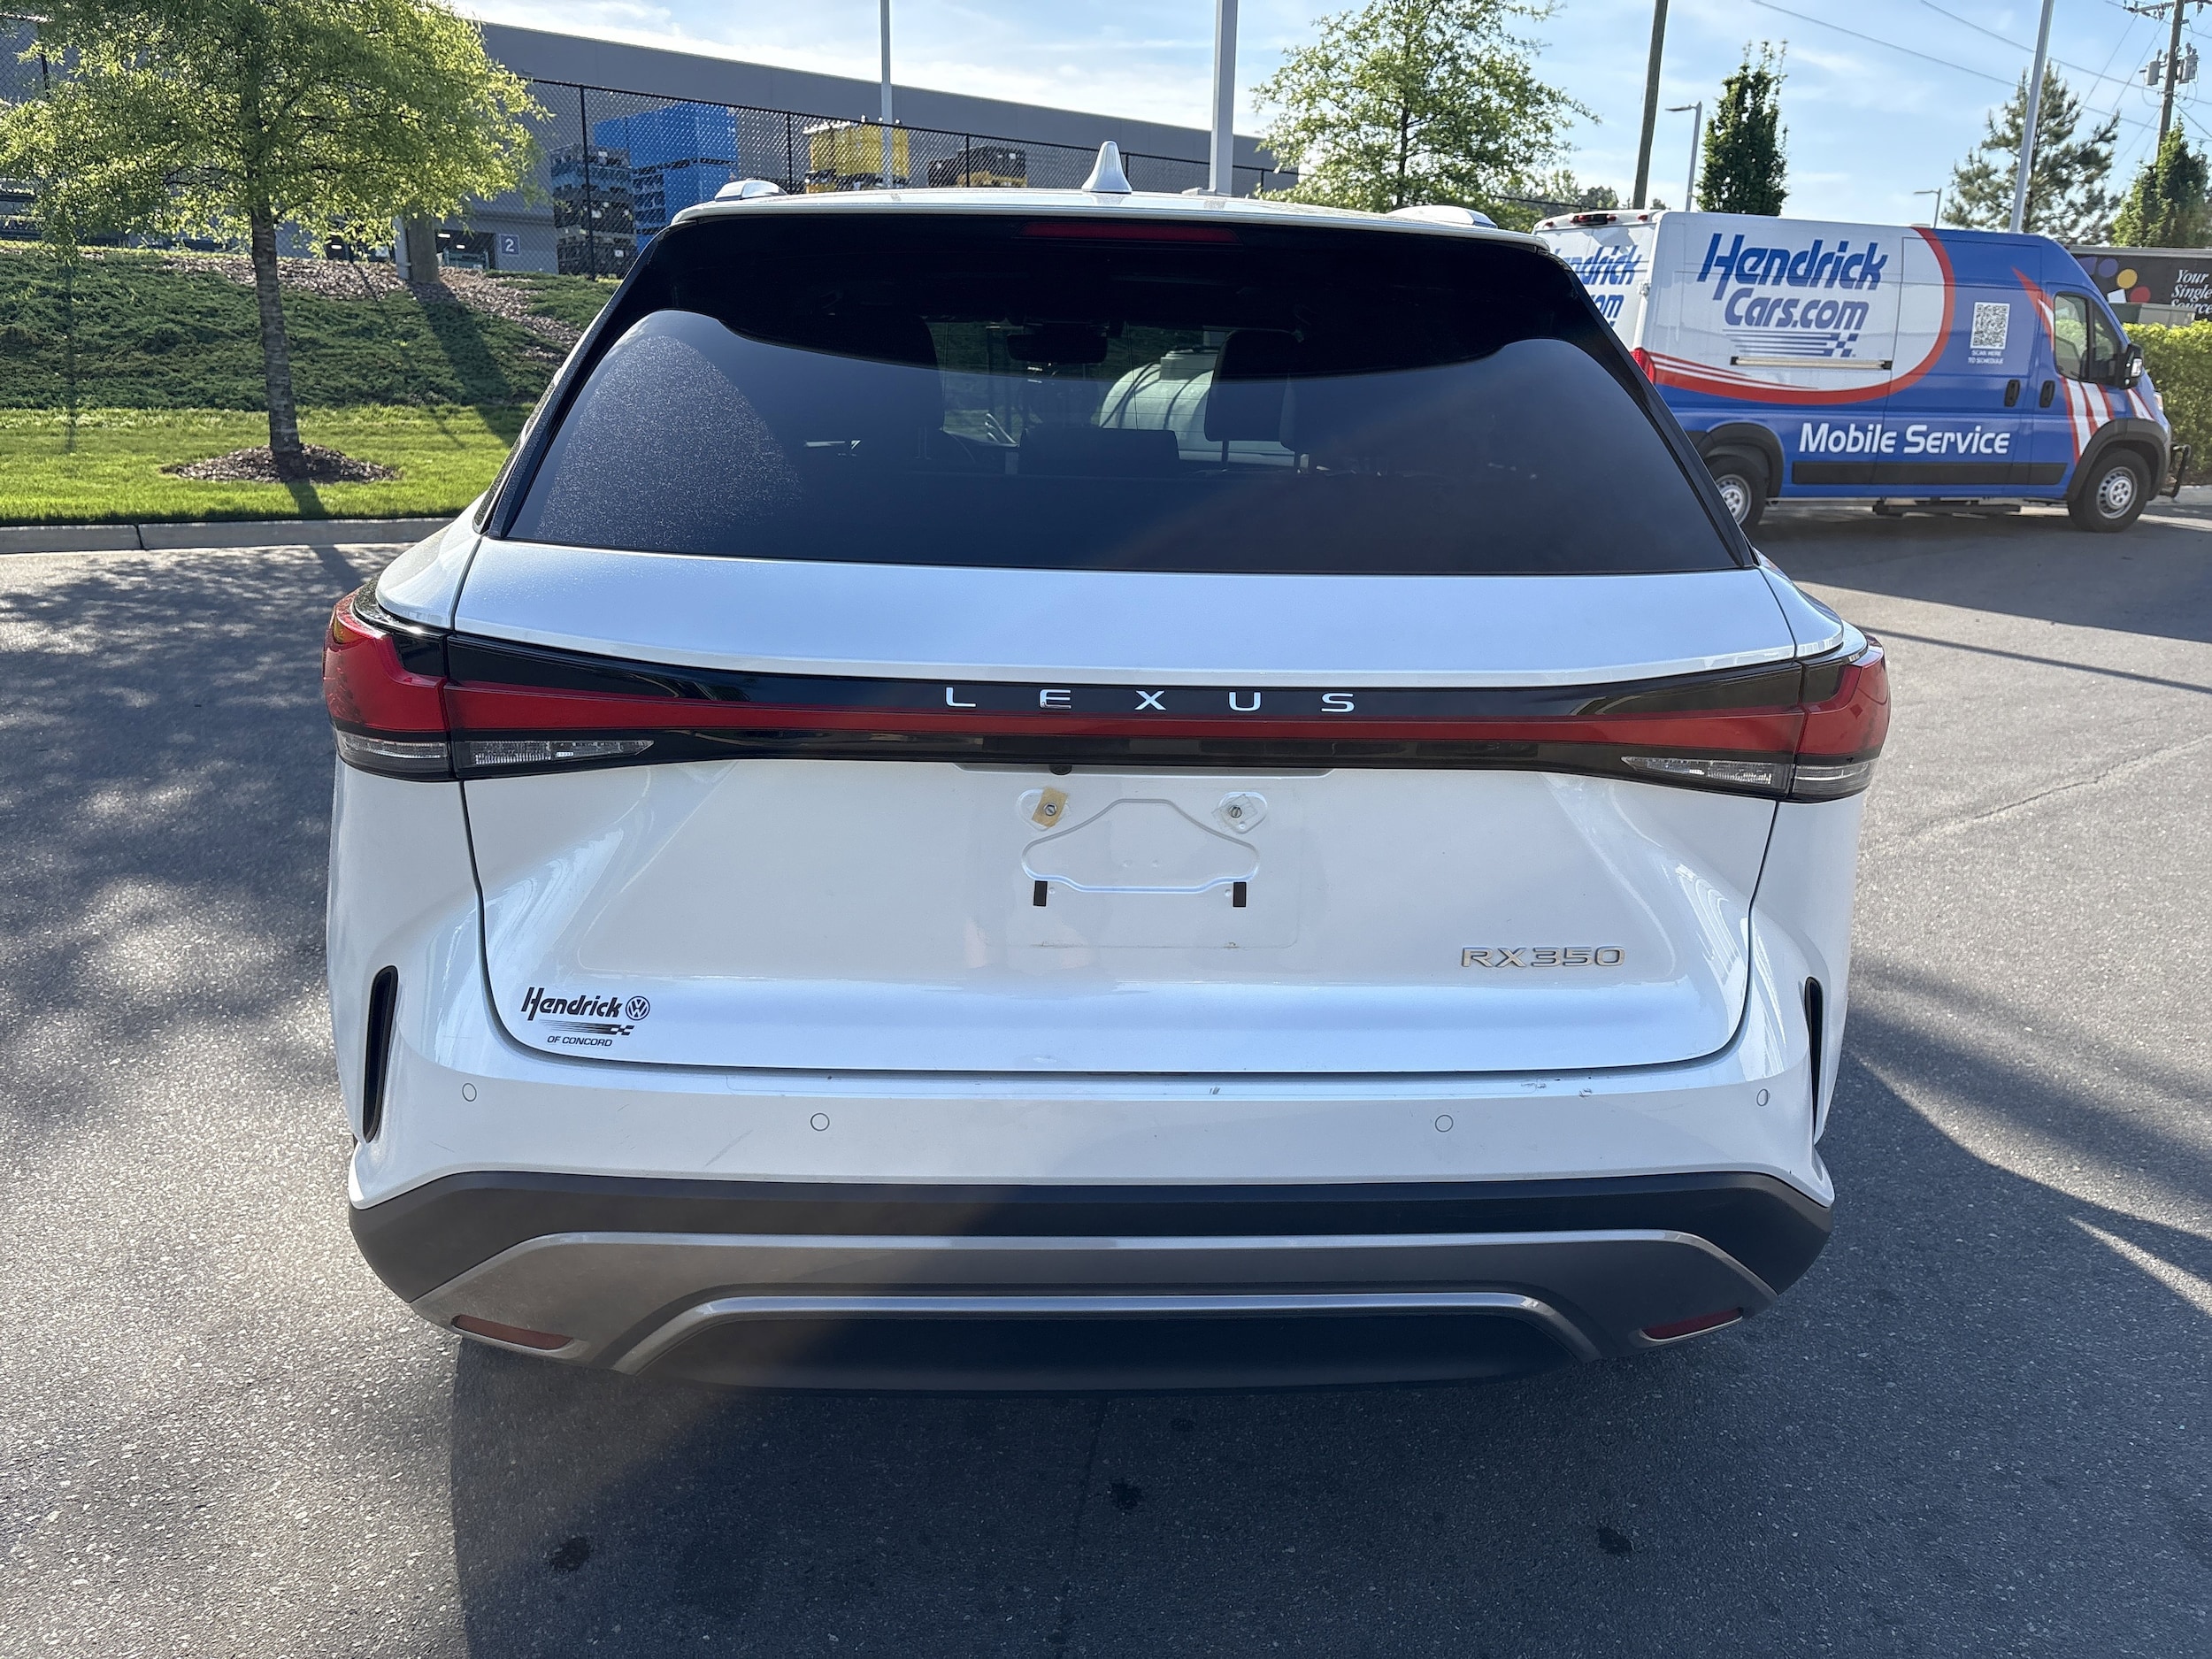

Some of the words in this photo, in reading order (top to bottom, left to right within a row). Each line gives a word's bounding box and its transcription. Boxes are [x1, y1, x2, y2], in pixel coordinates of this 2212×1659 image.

[505, 238, 514, 252] 2
[1555, 245, 1643, 285] ndrick
[1696, 233, 1889, 301] Hendrick
[2176, 269, 2210, 283] Your
[2170, 283, 2212, 303] Single
[1724, 288, 1870, 330] Cars.com
[1799, 422, 1897, 454] Mobile
[1904, 425, 2011, 454] Service
[945, 687, 1356, 713] LEXUS
[1462, 946, 1626, 967] RX350
[520, 987, 623, 1021] Hendrick
[547, 1035, 561, 1044] OF
[562, 1036, 613, 1047] CONCORD
